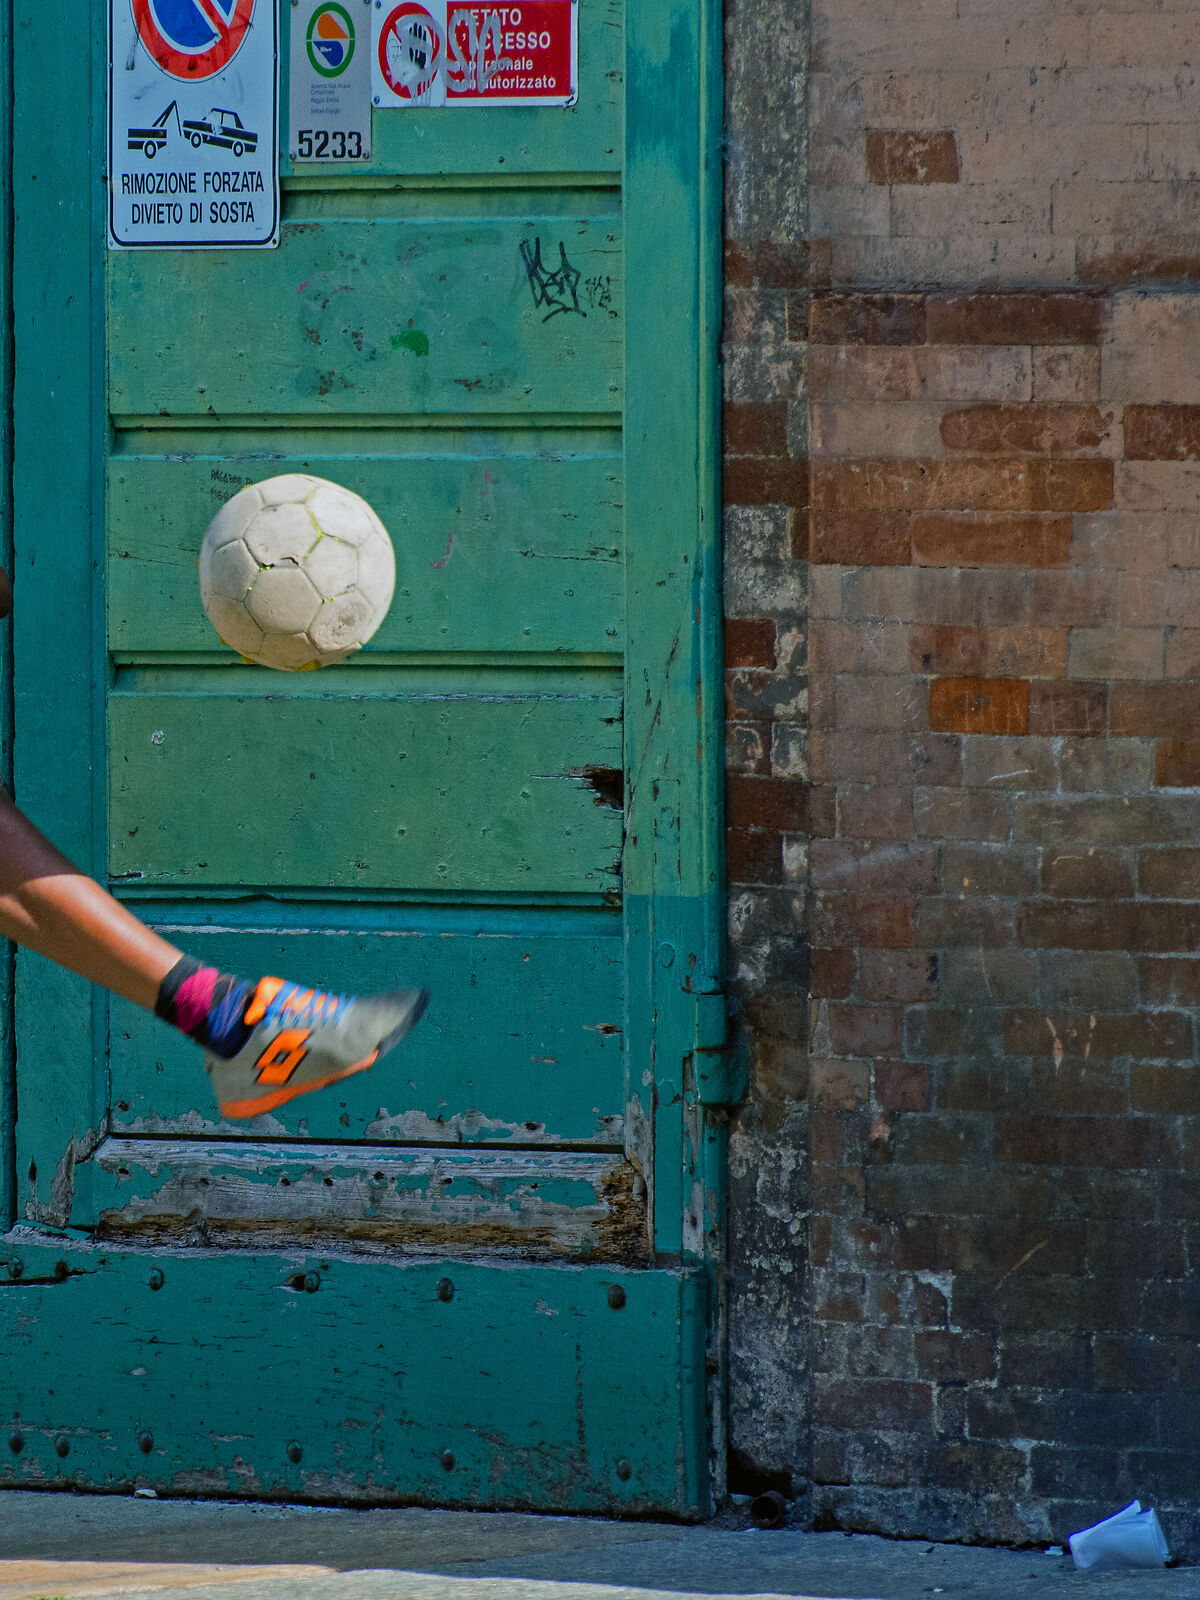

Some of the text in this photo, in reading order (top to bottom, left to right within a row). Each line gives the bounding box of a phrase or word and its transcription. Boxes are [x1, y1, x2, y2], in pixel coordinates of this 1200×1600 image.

[298, 129, 362, 159] 5233
[121, 171, 265, 194] RIMOZIONE FORZATA
[131, 202, 255, 225] DIVIETO DI SOSTA
